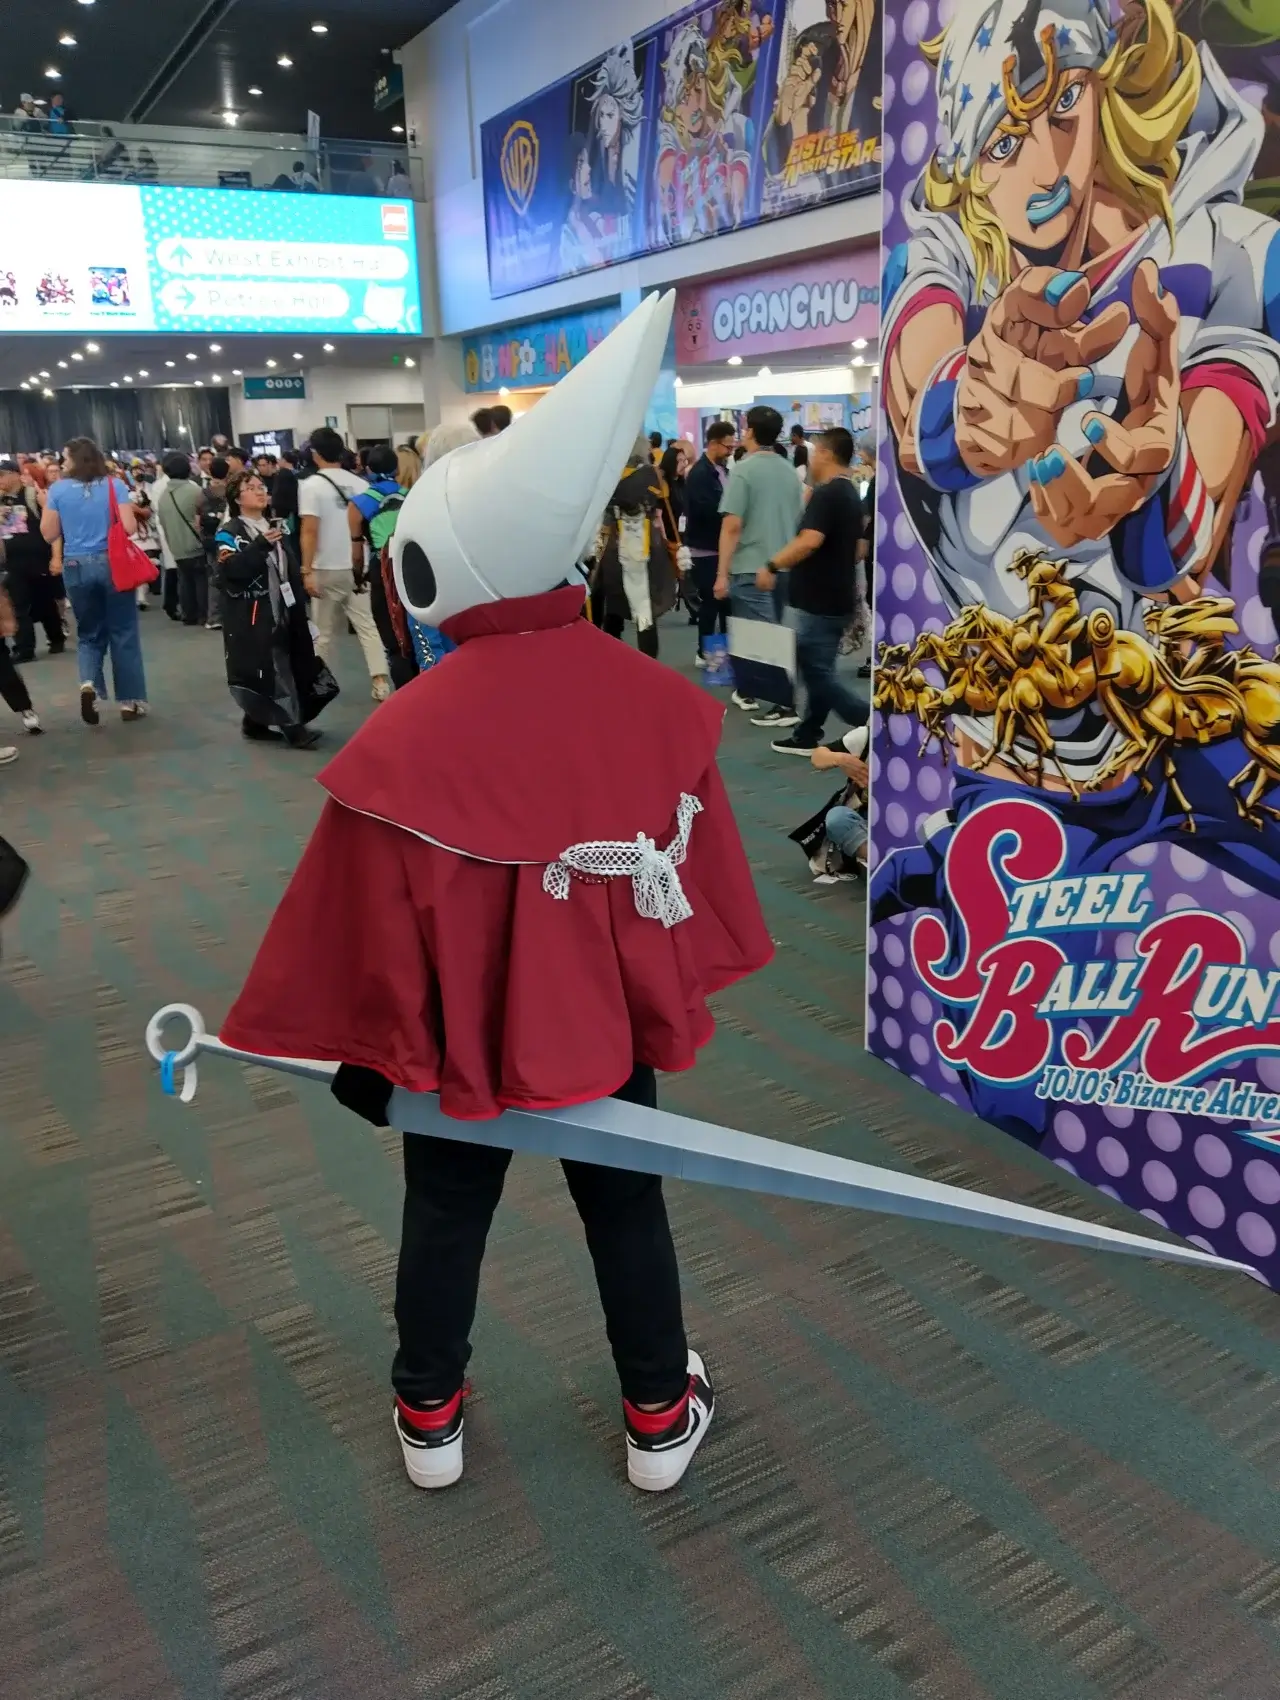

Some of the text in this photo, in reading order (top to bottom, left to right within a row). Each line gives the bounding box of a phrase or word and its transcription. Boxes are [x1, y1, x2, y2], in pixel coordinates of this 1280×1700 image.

[826, 137, 878, 174] STAR
[205, 248, 262, 267] West
[712, 278, 859, 343] OPANCHU
[911, 798, 1150, 1002] STEEL
[934, 911, 1280, 1087] BALL RUN
[1036, 1066, 1113, 1105] JOJO's
[1115, 1072, 1208, 1114] Bizarre
